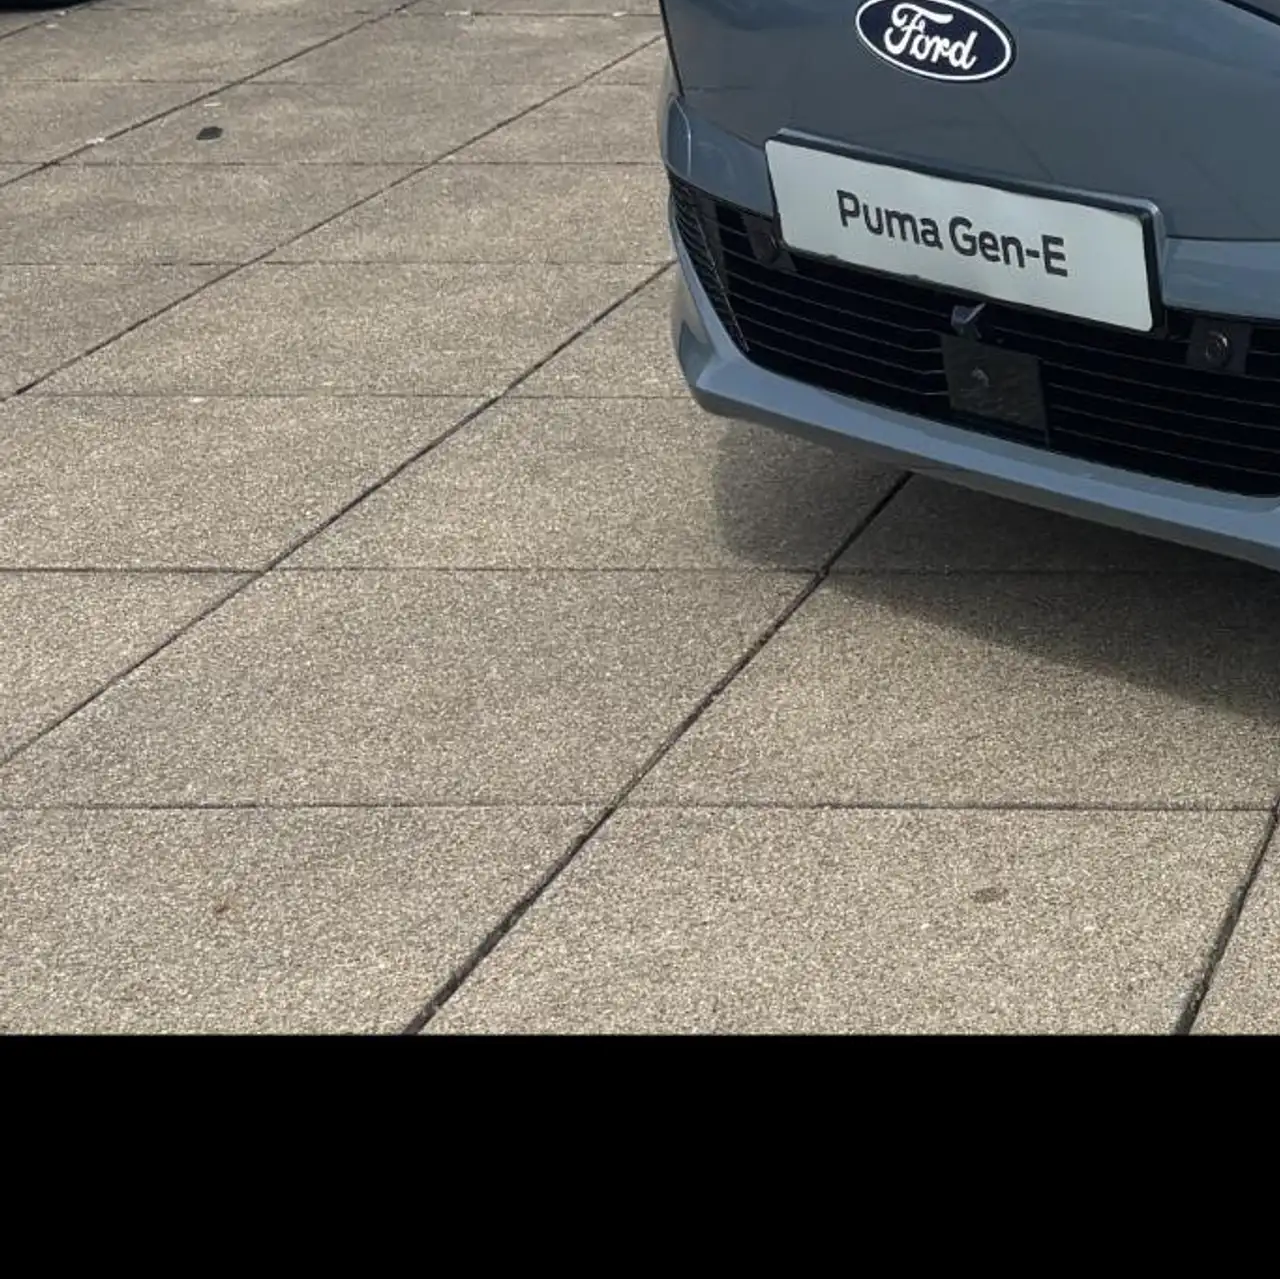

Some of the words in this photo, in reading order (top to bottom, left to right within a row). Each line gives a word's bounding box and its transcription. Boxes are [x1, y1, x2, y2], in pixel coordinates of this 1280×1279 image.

[883, 2, 979, 71] Ford
[836, 189, 944, 251] Puma
[948, 216, 1068, 278] Gen-E
